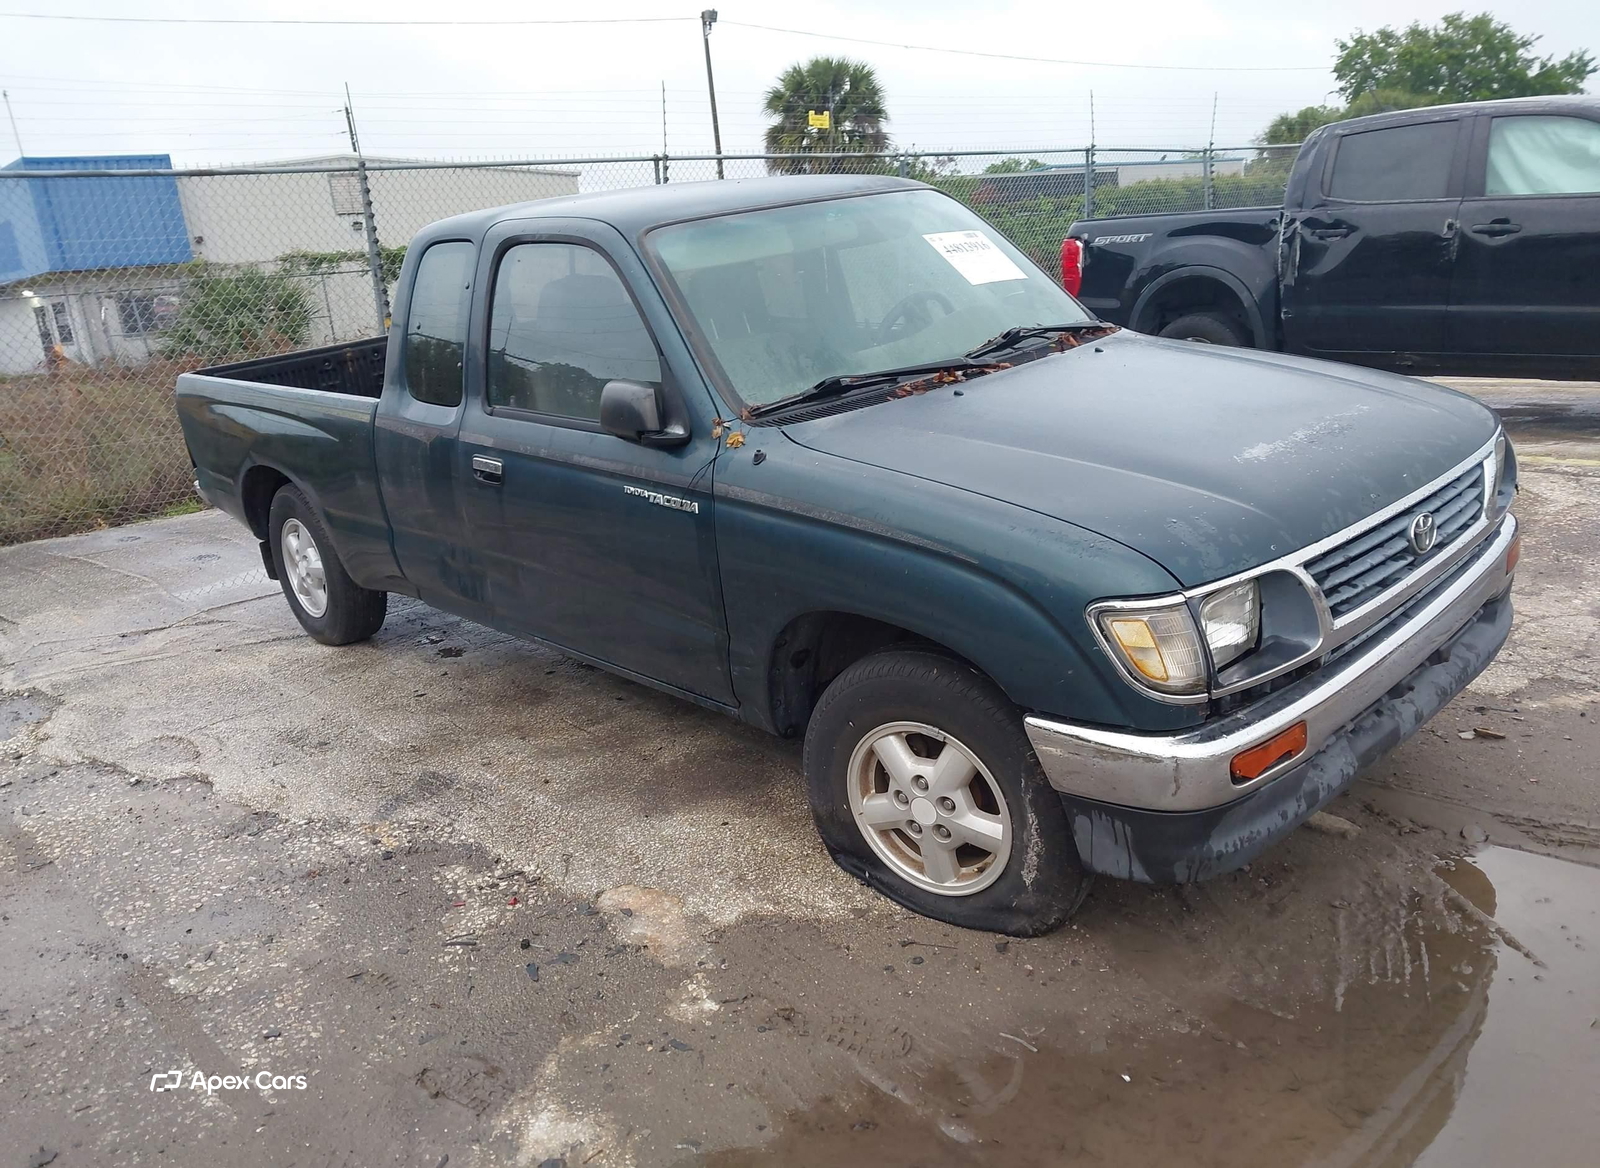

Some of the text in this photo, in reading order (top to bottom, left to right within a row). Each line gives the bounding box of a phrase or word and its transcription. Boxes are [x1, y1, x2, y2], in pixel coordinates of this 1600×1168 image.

[1089, 232, 1154, 246] SPORT
[623, 485, 699, 514] TOYOTA TACOMA
